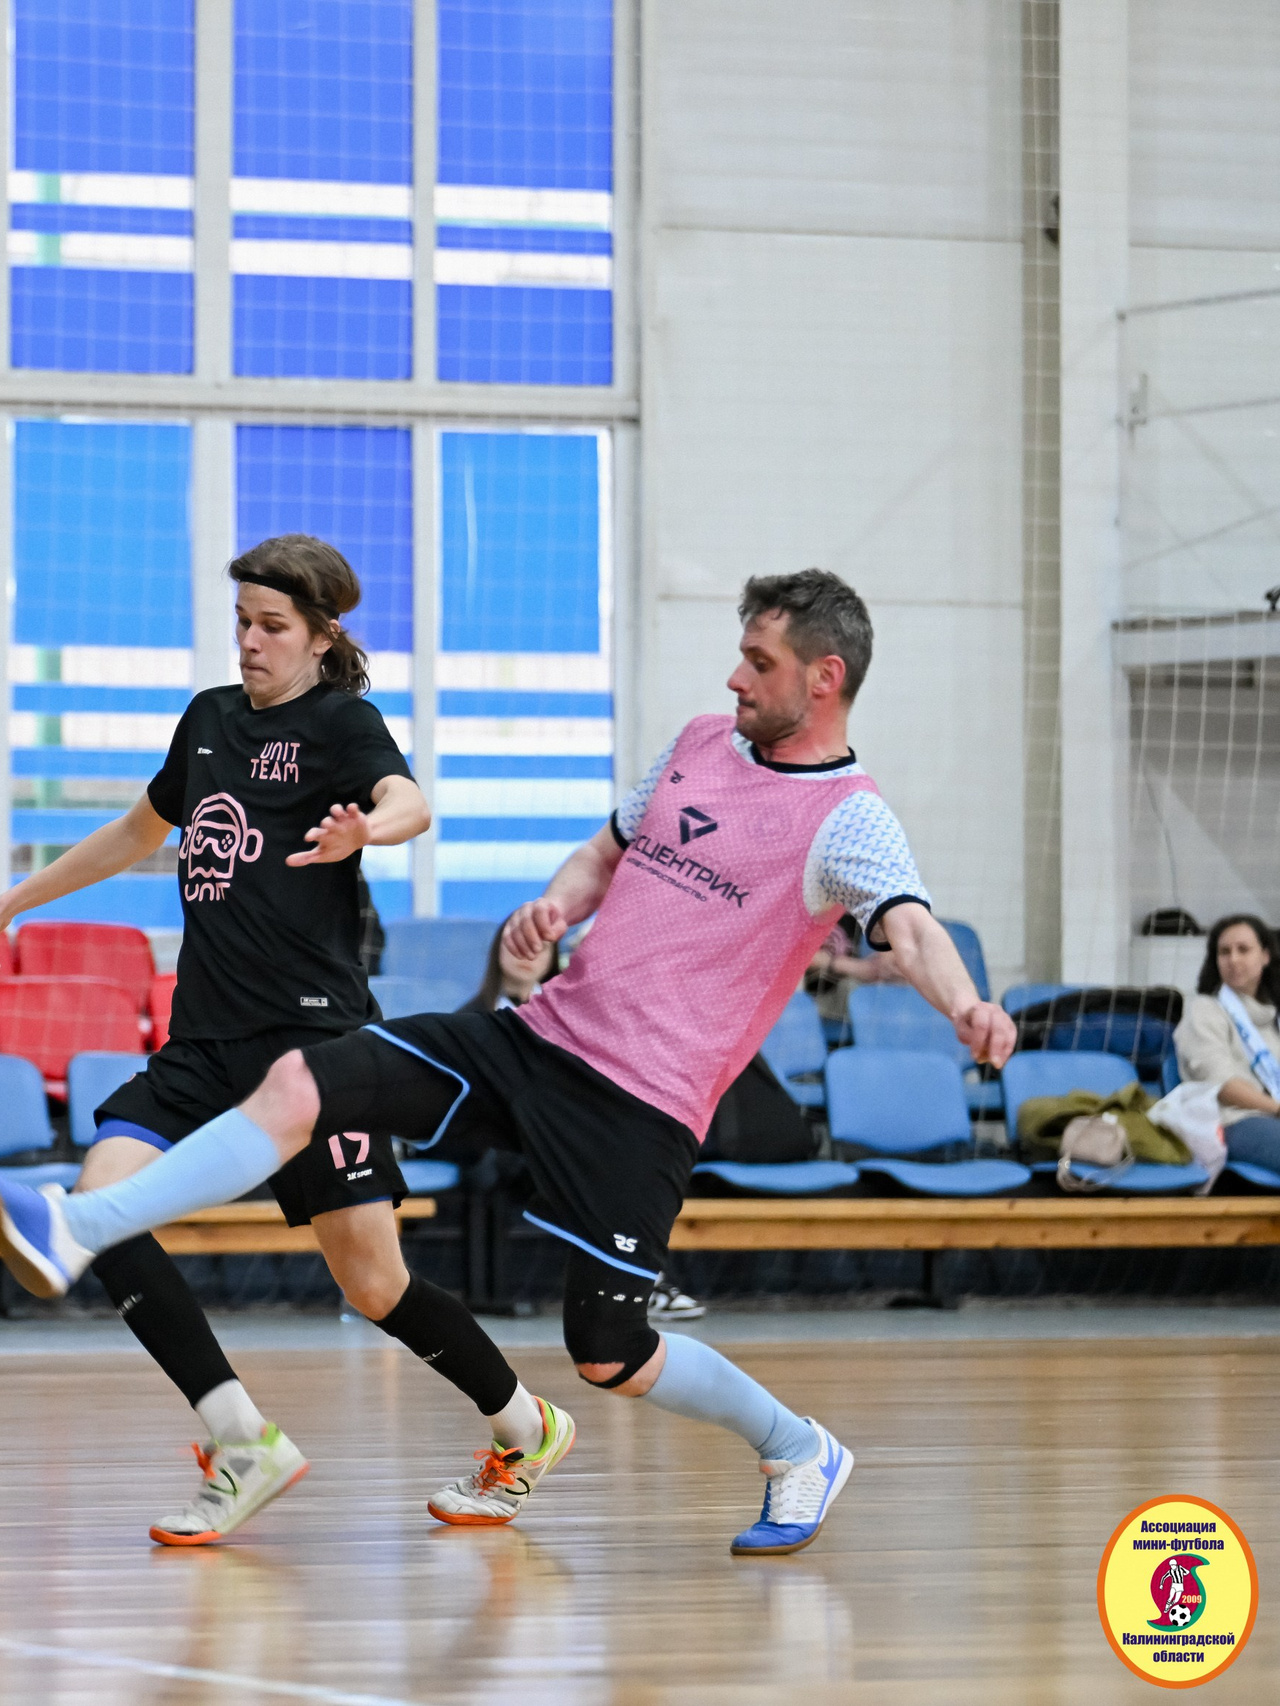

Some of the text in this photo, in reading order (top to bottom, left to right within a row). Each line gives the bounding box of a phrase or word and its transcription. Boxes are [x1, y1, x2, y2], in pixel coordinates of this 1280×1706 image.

[260, 741, 301, 762] UNIT
[250, 758, 299, 784] TEAM
[631, 834, 750, 909] СЦЕНТРИК
[328, 1131, 370, 1170] 17
